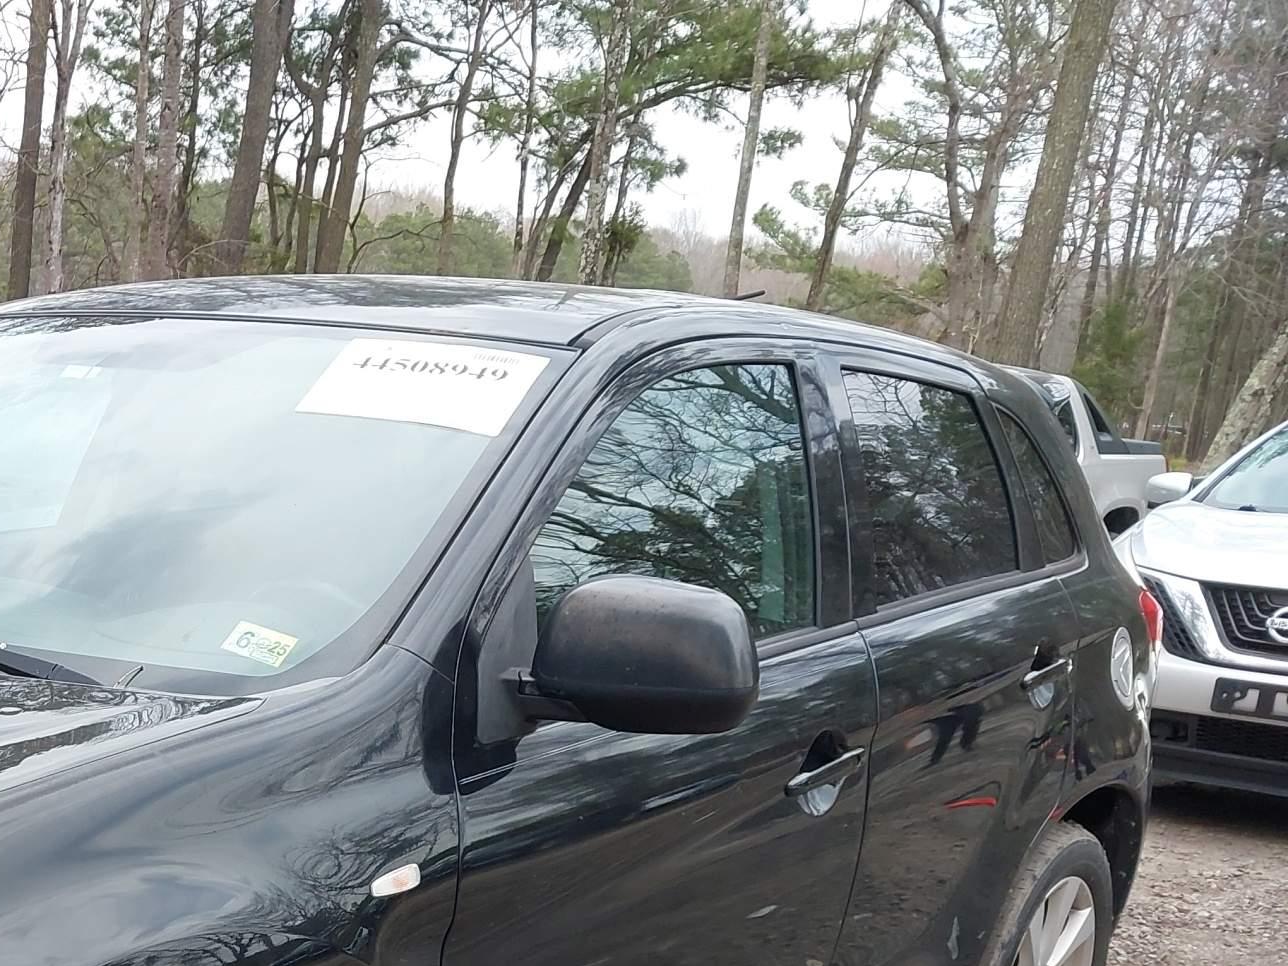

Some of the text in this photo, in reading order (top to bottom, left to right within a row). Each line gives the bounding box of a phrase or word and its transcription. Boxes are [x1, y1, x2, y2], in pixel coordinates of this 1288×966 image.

[352, 356, 509, 381] 44508949
[236, 631, 291, 656] 6 25
